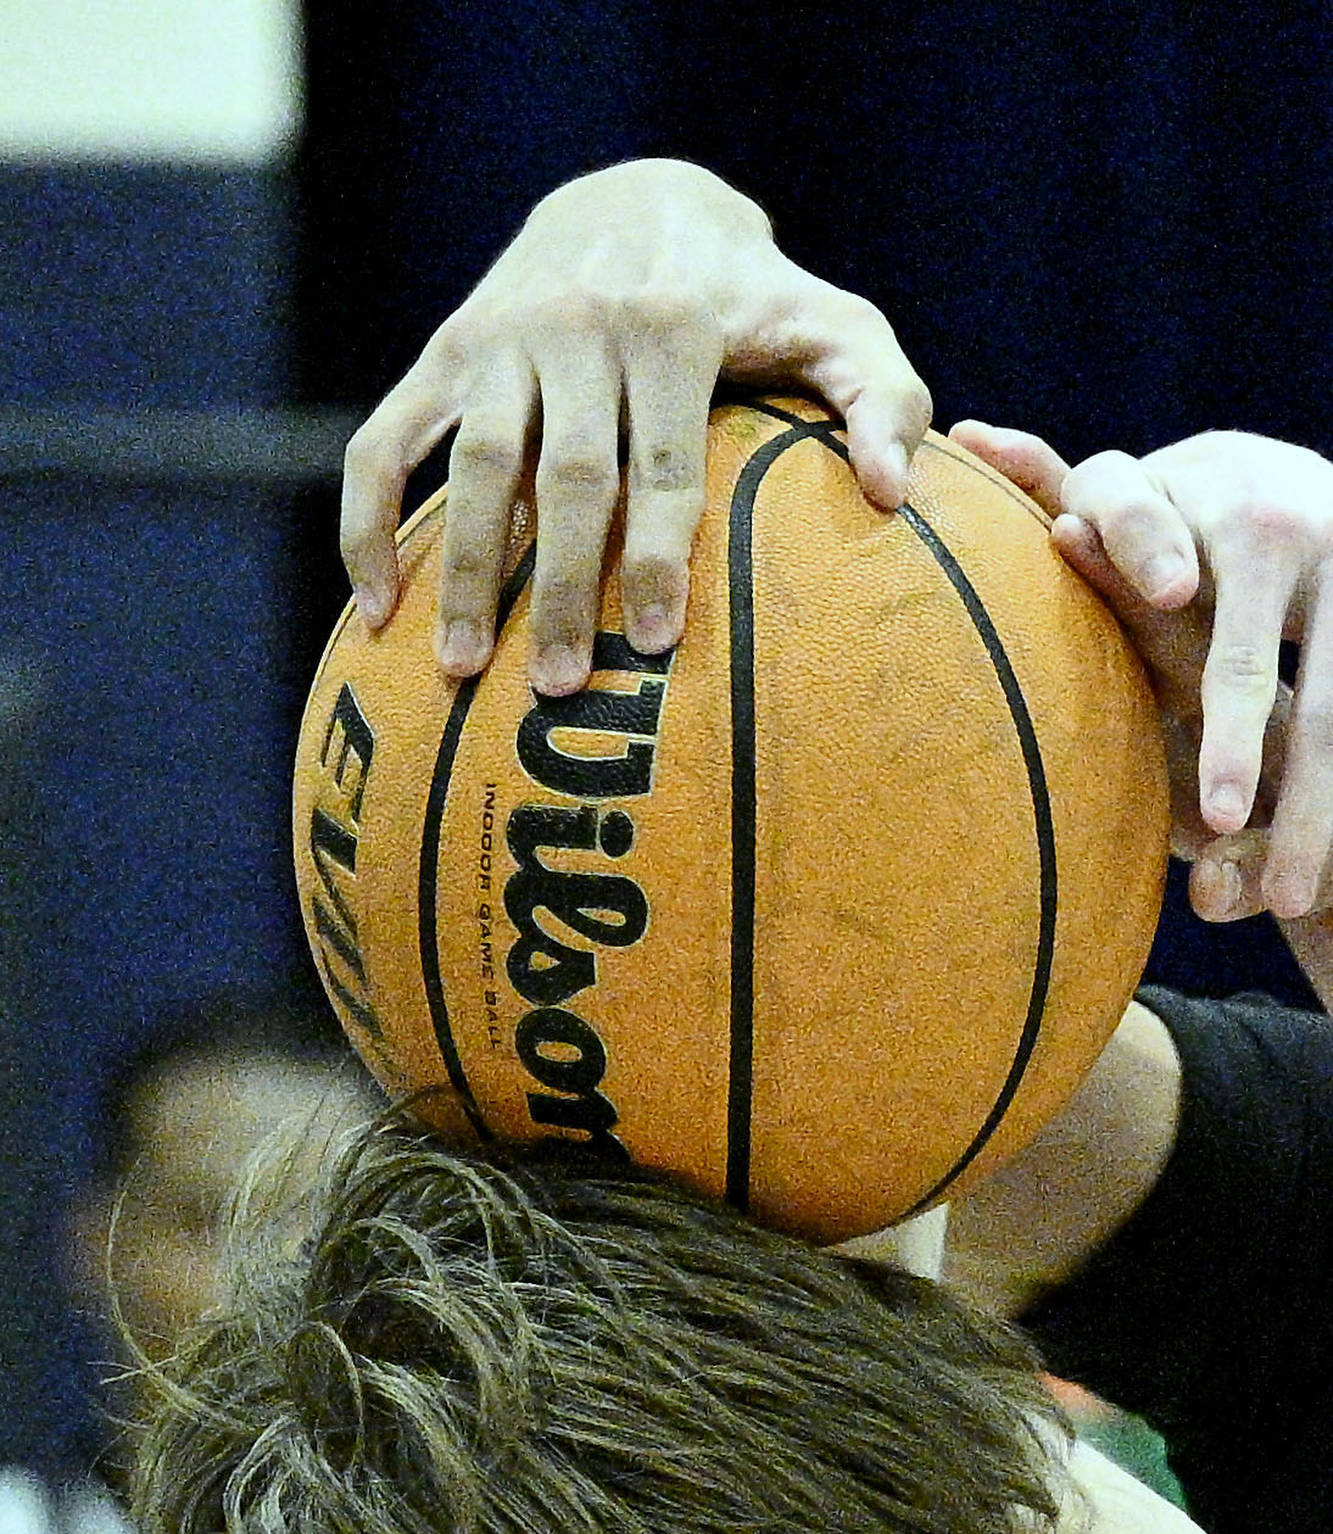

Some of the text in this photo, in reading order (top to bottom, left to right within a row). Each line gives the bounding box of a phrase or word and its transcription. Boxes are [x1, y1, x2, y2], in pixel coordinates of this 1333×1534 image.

[480, 783, 501, 1049] INDOOR GAME BALL
[502, 629, 678, 1164] Wilson
